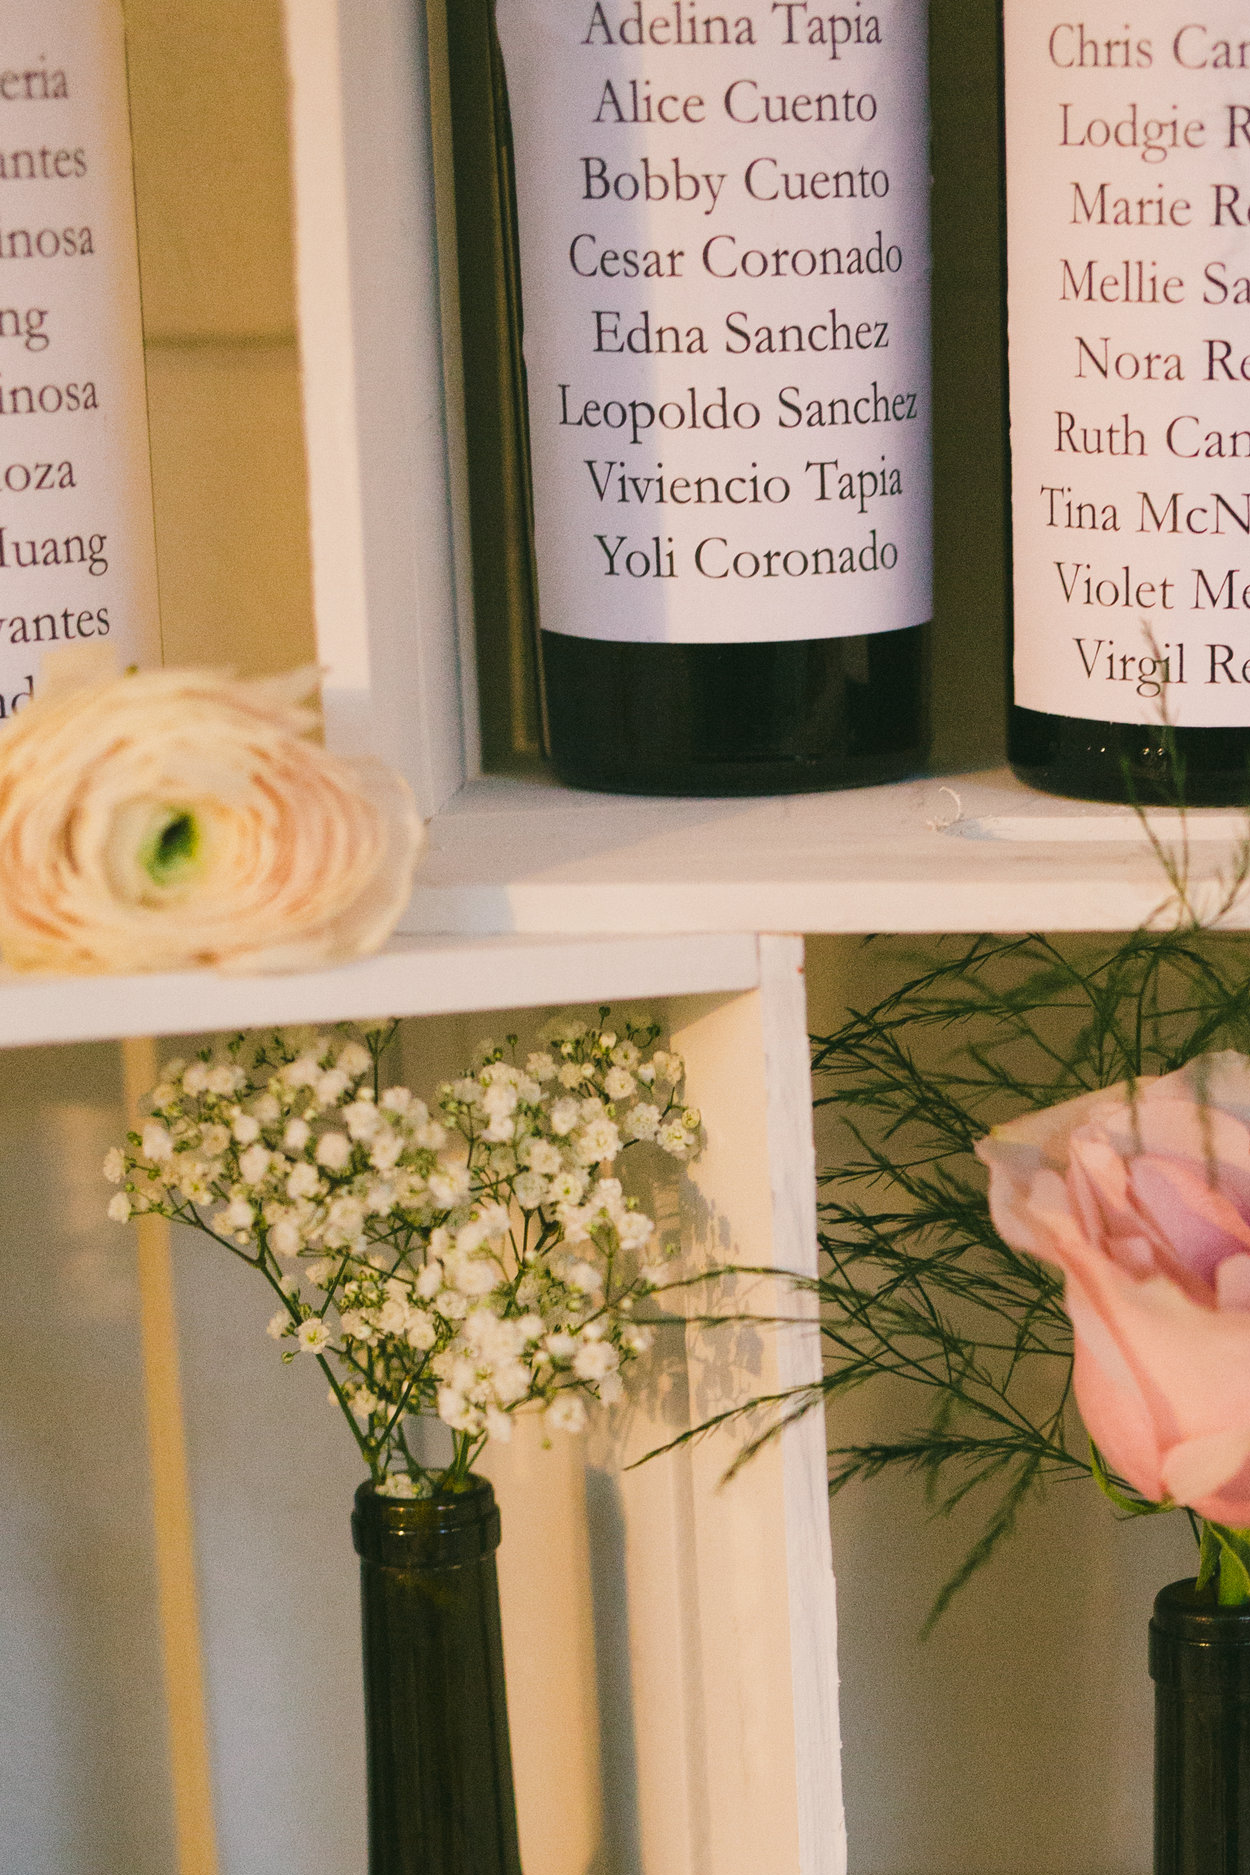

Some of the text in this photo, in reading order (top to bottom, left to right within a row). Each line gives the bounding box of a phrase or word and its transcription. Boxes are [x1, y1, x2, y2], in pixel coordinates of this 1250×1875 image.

[581, 0, 882, 60] Adelina Tapia
[1047, 22, 1153, 70] Chris
[592, 79, 878, 123] Alice Cuento
[1058, 102, 1206, 164] Lodgie
[580, 156, 890, 215] Bobby Cuento
[1069, 181, 1193, 227] Marie
[569, 230, 903, 278] Cesar Coronado
[1059, 259, 1186, 305] Mellie
[591, 307, 890, 354] Edna Sanchez
[1074, 336, 1186, 381] Nora
[557, 381, 918, 444] Leopoldo Sanchez
[1054, 411, 1148, 457] Ruth
[0, 460, 76, 492] oza
[583, 455, 903, 513] Viviencio Tapia
[1040, 485, 1122, 532] Tina
[593, 529, 899, 579] Yoli Coronado
[1053, 561, 1175, 609] Violet
[0, 607, 110, 644] antes
[1072, 637, 1187, 698] Virgil
